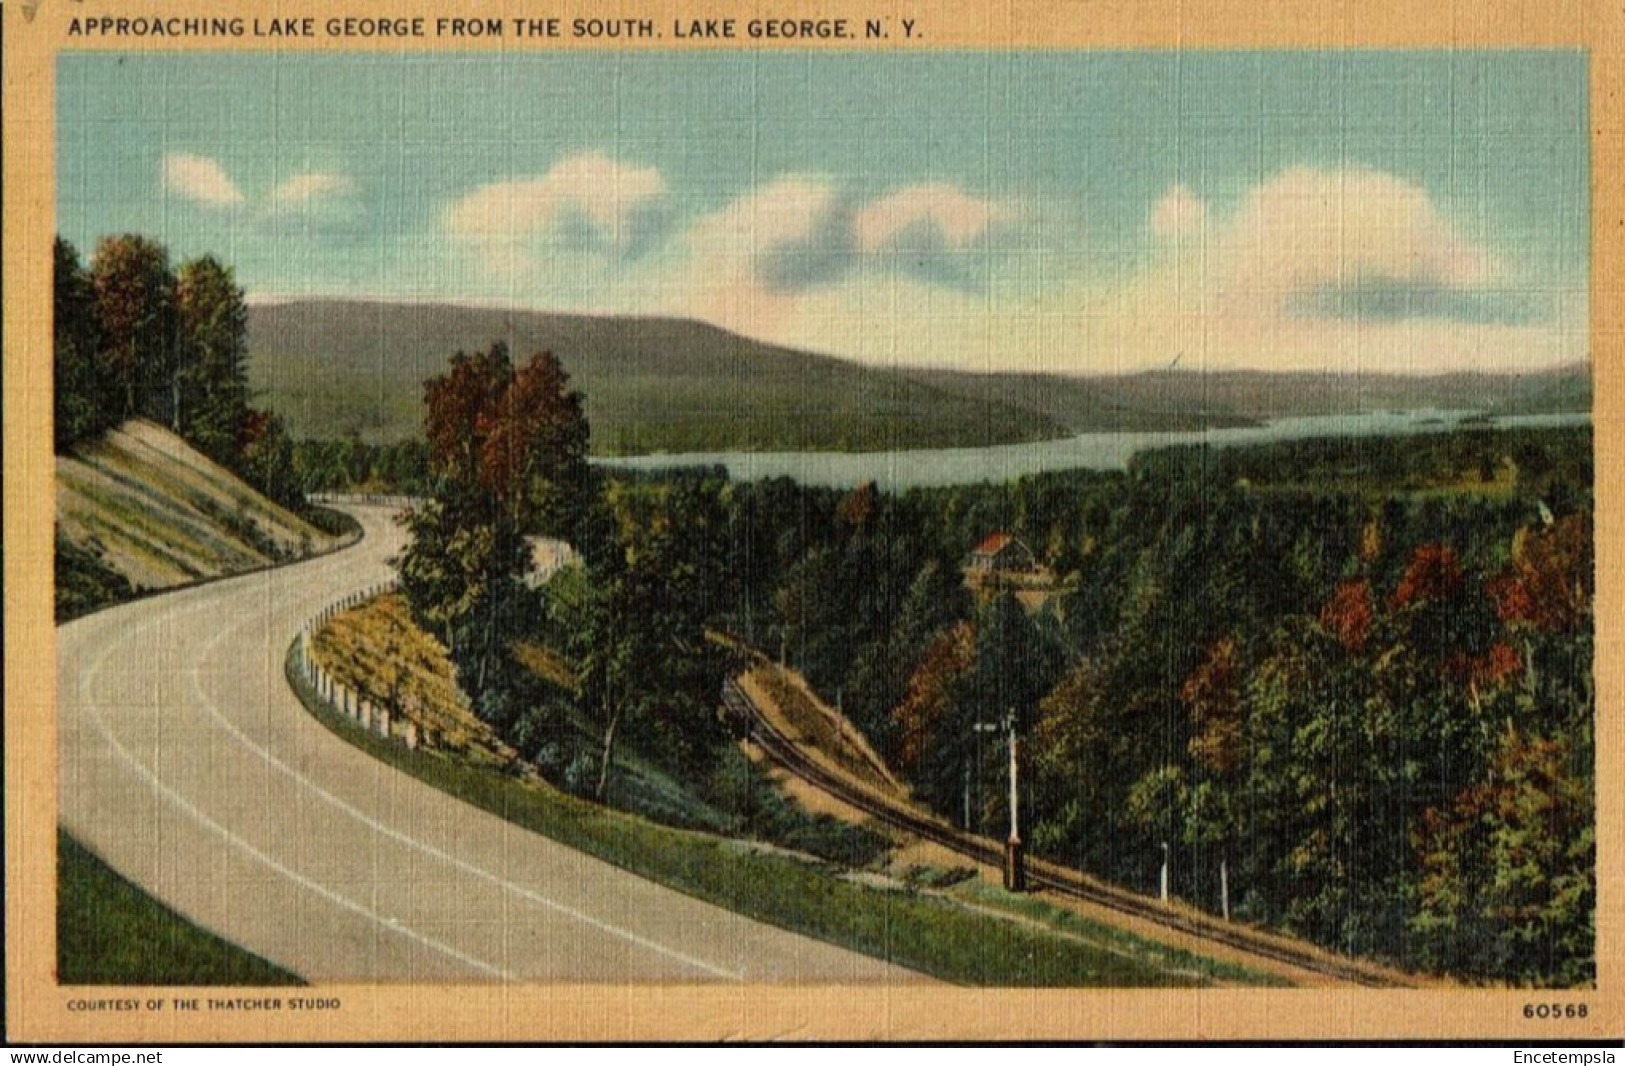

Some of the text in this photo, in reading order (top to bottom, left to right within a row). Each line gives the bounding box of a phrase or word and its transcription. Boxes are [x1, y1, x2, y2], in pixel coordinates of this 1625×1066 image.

[67, 17, 245, 37] APPROACHING
[253, 17, 315, 37] LAKE
[325, 17, 425, 37] GEORGE
[436, 17, 503, 37] FROM
[513, 18, 560, 37] THE
[674, 18, 736, 38] LAKE
[865, 18, 889, 39] N.
[902, 19, 924, 39] Y.
[66, 998, 341, 1011] COURTESY OF THE THATCHER STUDIO
[1522, 1003, 1588, 1019] 60568
